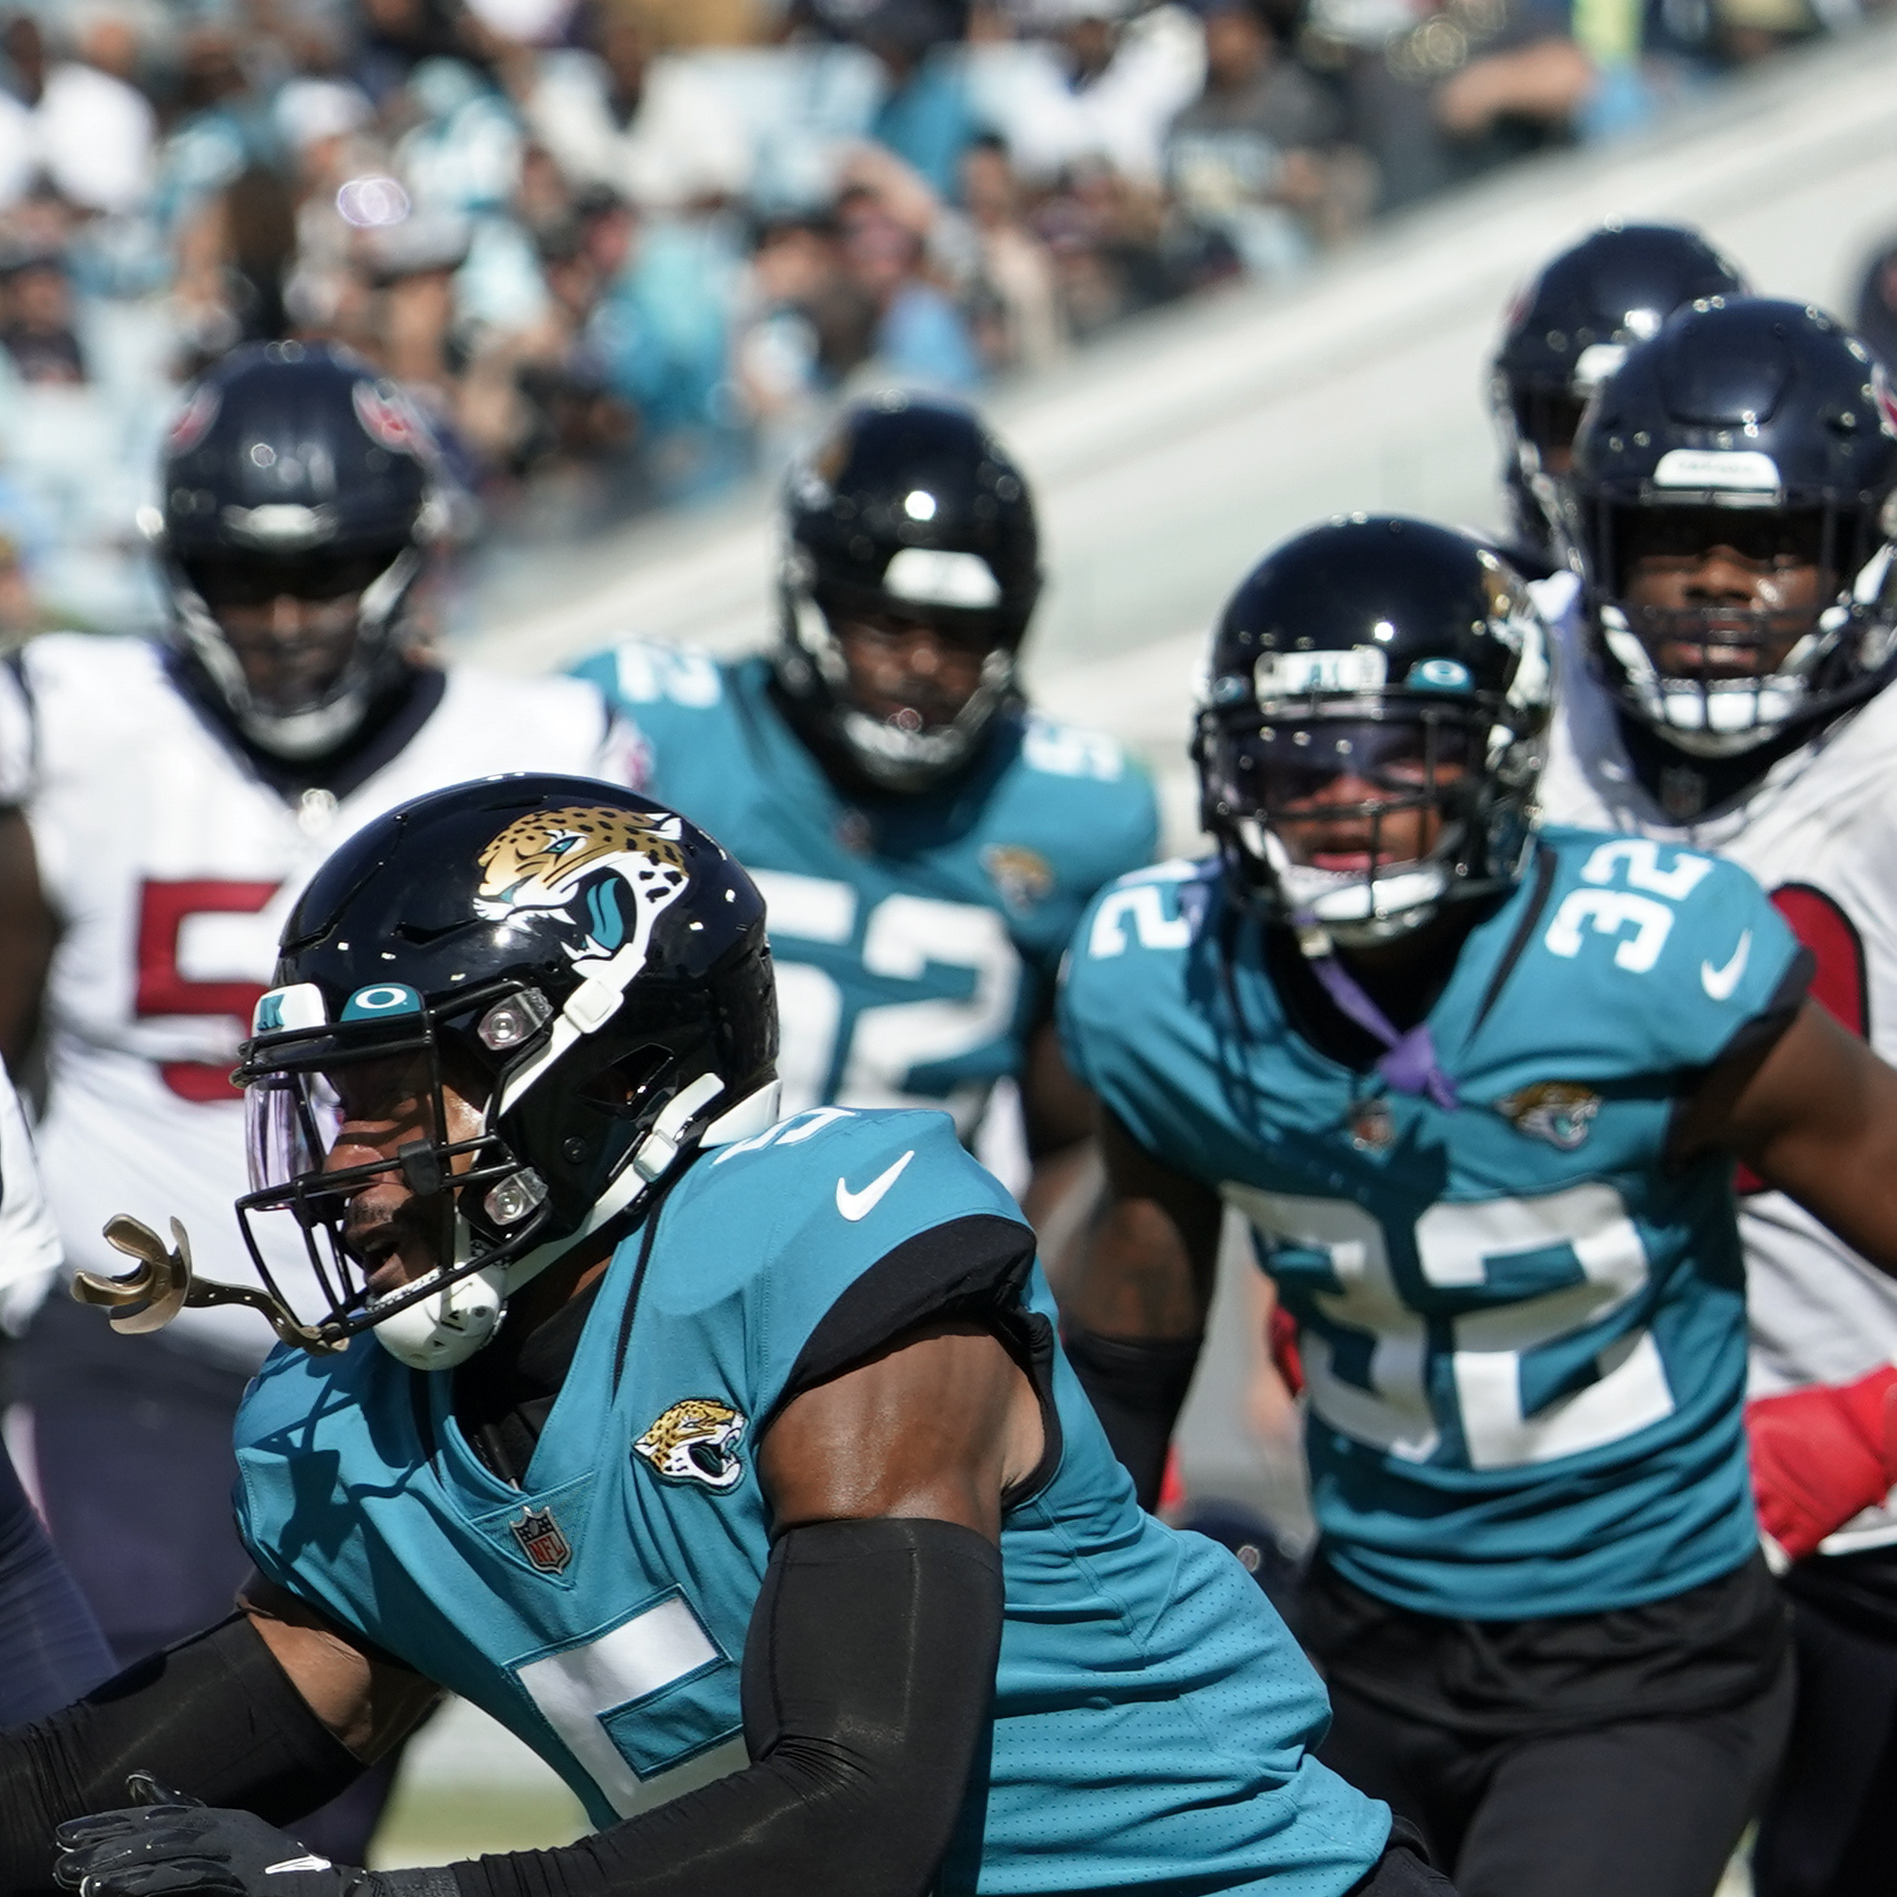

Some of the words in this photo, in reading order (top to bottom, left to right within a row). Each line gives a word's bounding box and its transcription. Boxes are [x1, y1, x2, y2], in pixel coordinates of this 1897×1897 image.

[745, 866, 1022, 1125] 52
[1545, 842, 1713, 973] 32
[1217, 1180, 1675, 1470] 32
[528, 1535, 564, 1562] NFL
